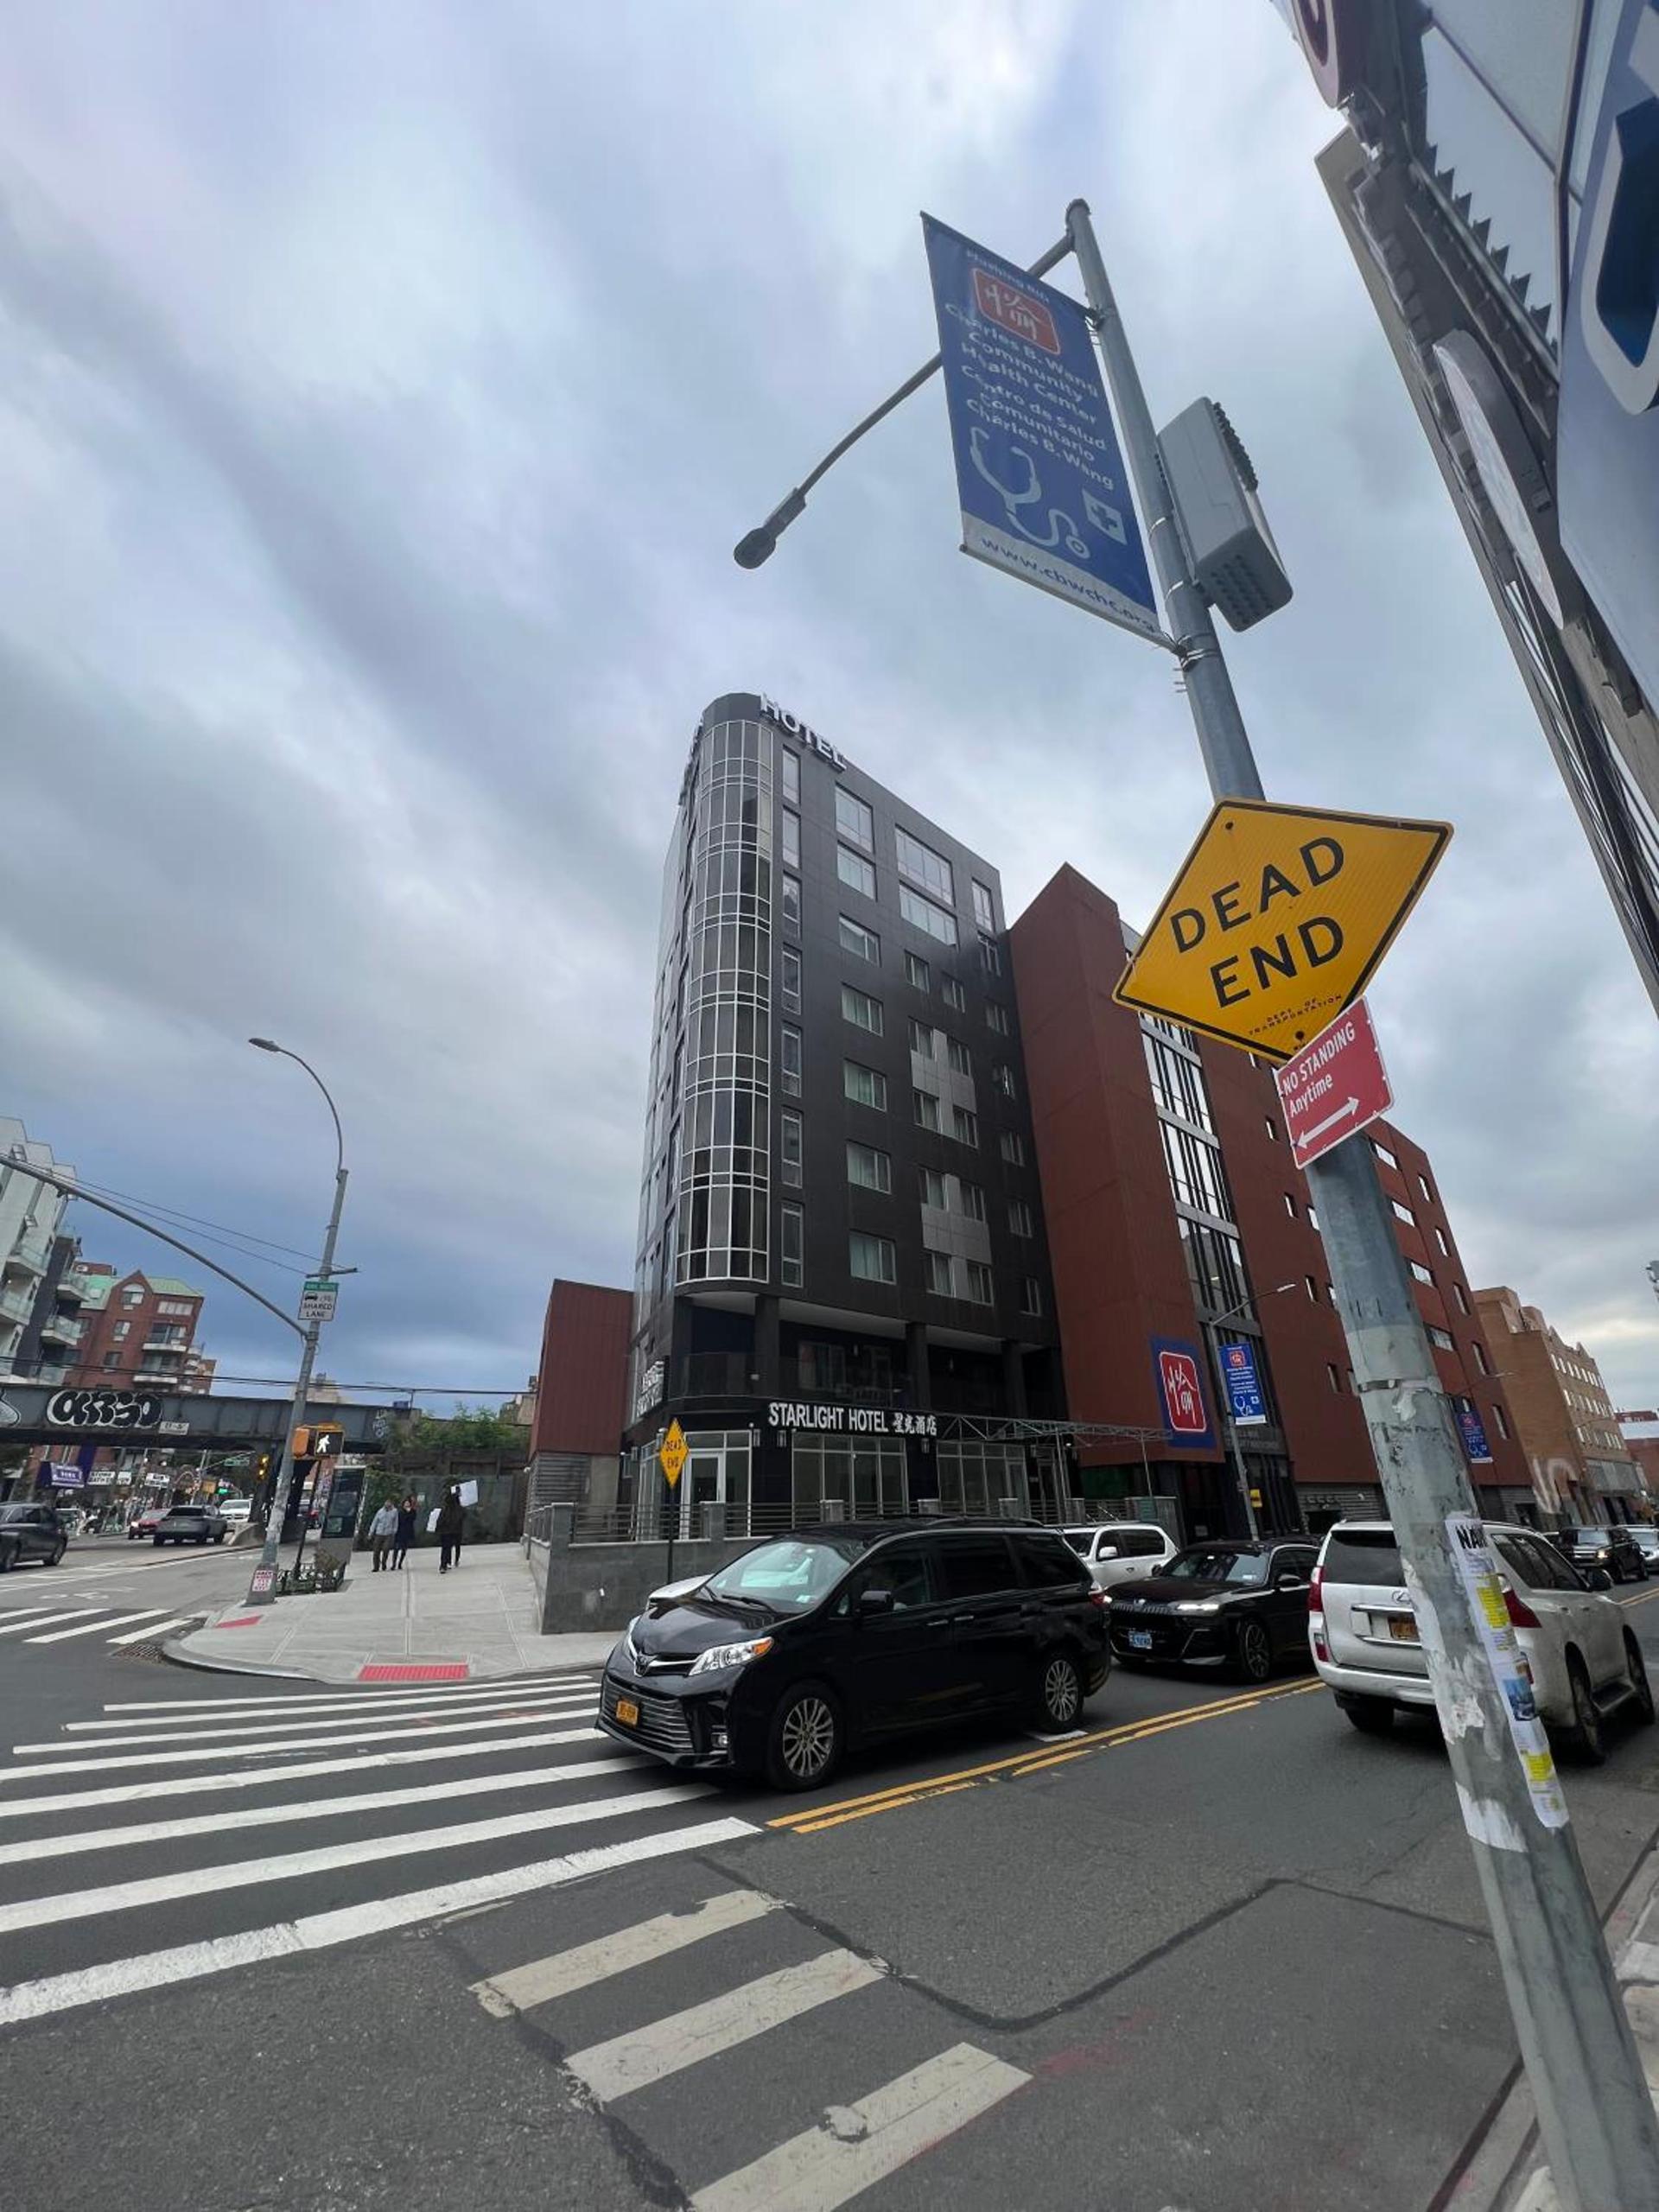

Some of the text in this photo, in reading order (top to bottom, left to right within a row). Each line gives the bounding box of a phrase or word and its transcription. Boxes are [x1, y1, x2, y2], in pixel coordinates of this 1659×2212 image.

[962, 342, 1096, 424] Health Center
[969, 332, 1082, 402] Community
[962, 365, 1107, 449] Centro de Salud
[967, 398, 1039, 445] Charles
[1063, 450, 1114, 490] Wang
[980, 392, 1095, 461] Comunitario
[760, 692, 847, 769] HOTEL
[1170, 837, 1344, 953] DEAD
[1211, 916, 1344, 1007] END
[1282, 1021, 1356, 1096] NO STANDING
[1289, 1073, 1334, 1118] Anytime
[666, 1439, 682, 1452] DEAD
[768, 1402, 844, 1430] STARLIGHT
[849, 1408, 889, 1433] HOTEL
